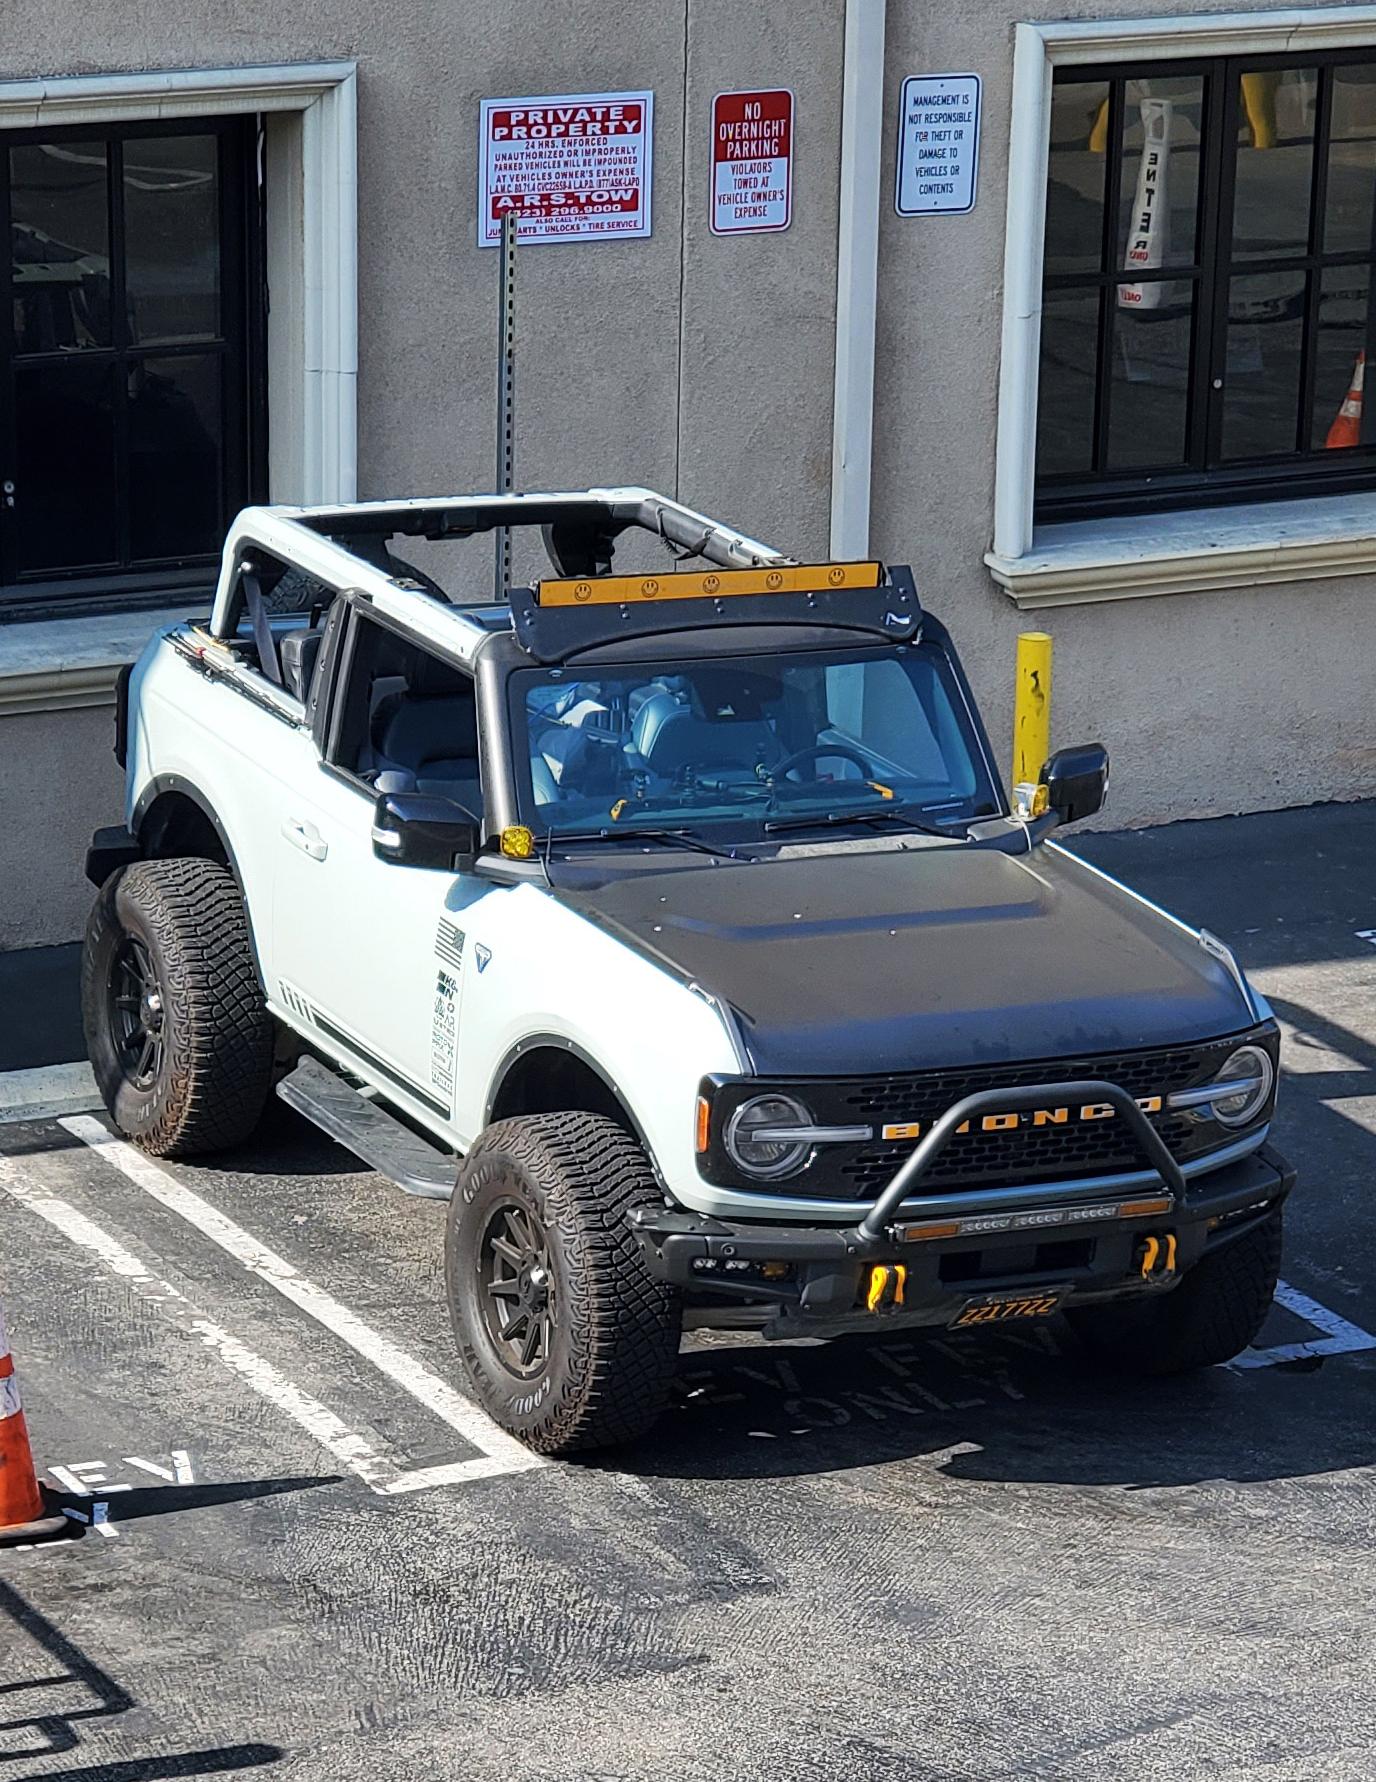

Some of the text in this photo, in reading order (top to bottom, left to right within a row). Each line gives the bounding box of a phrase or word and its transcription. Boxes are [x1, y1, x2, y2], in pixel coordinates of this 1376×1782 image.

[913, 94, 969, 107] MANAGEMENT IS
[510, 106, 624, 125] PRIVATE
[744, 102, 761, 119] NO
[908, 112, 972, 125] NOT RESPONSIBLE
[495, 119, 639, 140] PROPERTY
[719, 119, 787, 141] OVERNIGHT
[915, 130, 964, 142] FOR THEFT OR
[525, 137, 608, 150] 24 HRS. ENFORCED
[726, 139, 780, 158] PARKING
[495, 146, 637, 162] UNAUTHORIZED OR IMPROPERLY
[919, 148, 958, 160] DAMAGE TO
[494, 156, 638, 172] PARKED VEHICLES WILL BE IMPOUNDED
[731, 162, 773, 176] VIOLATORS
[496, 168, 636, 183] AT VEHICLES OWNER'S EXPENSE
[915, 166, 960, 178] VEHICLES OR
[734, 176, 770, 190] TOWED AT
[919, 182, 954, 195] CONTENTS
[718, 189, 785, 206] VEHICLE OWNER'S
[734, 204, 768, 219] EXPENSE
[545, 222, 581, 233] UNLOCKS
[588, 222, 605, 230] TIRE
[607, 220, 638, 228] SERVICE
[882, 1095, 1162, 1140] BONCO
